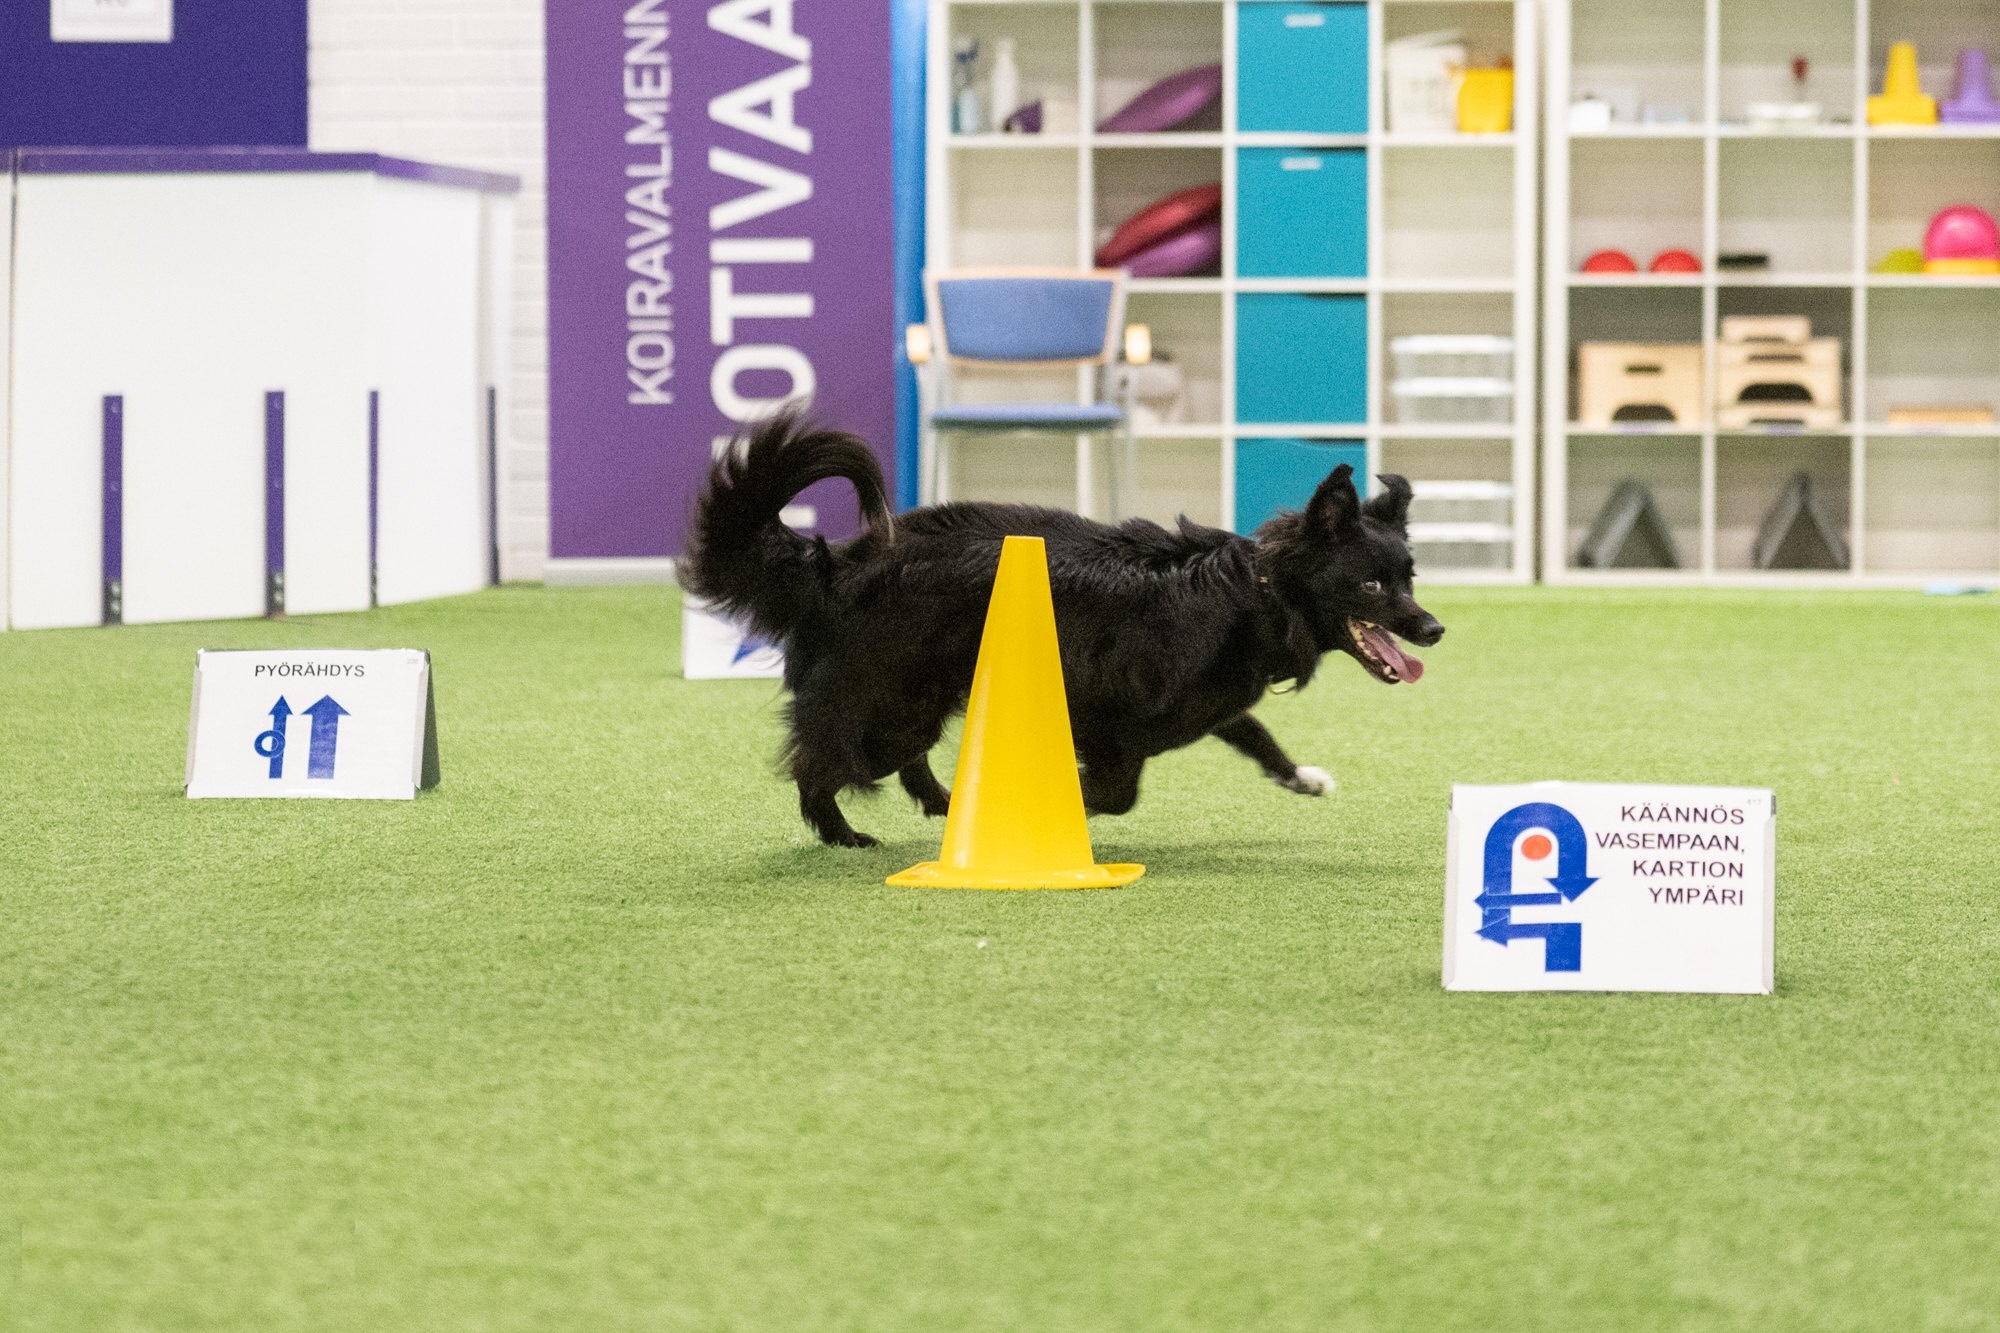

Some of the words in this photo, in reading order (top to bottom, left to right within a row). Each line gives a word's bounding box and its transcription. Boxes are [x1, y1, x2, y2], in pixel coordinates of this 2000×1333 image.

[707, 0, 815, 528] OTIVAA
[254, 661, 366, 678] PYÖRÄHDYS
[1621, 803, 1745, 825] KÄÄNNÖS
[1595, 832, 1745, 853] VASEMPAAN,
[1632, 860, 1744, 879] KARTION
[1648, 885, 1744, 906] YMPÄRI
